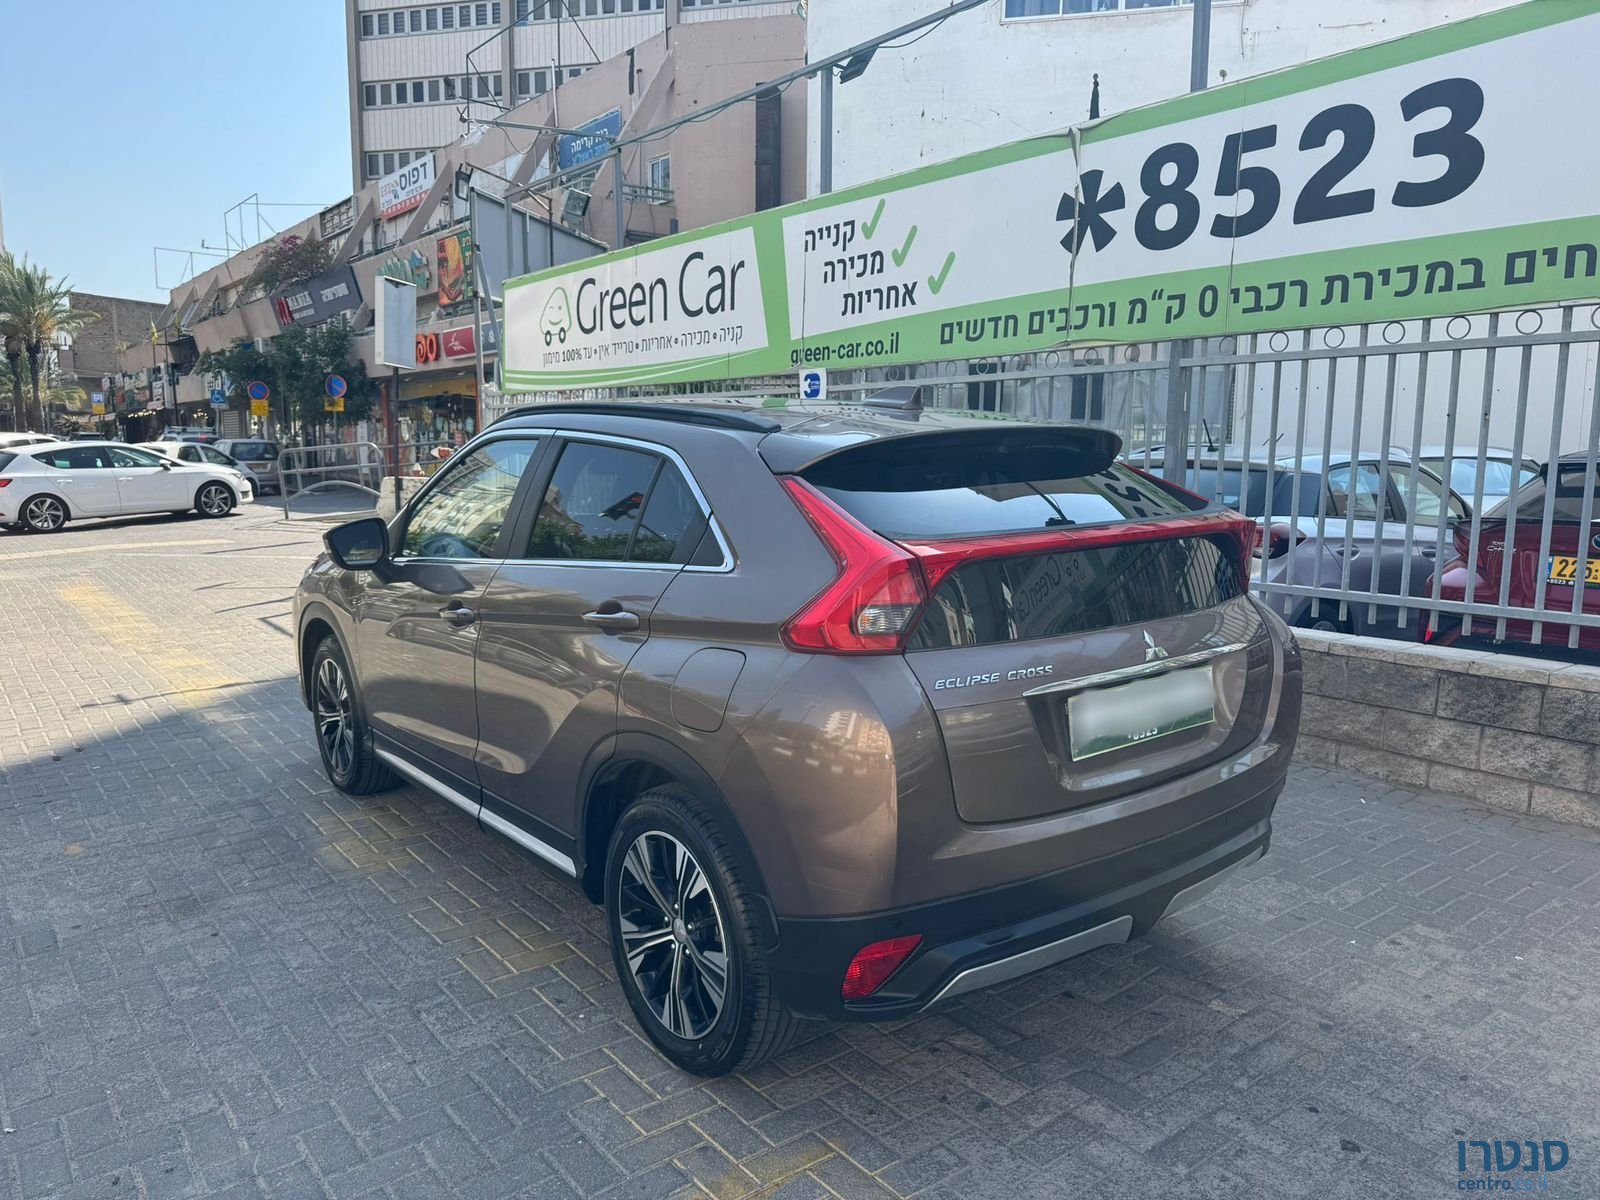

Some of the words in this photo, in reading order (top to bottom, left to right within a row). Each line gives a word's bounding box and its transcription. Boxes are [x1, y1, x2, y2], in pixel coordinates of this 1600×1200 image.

[399, 162, 427, 191] דפוס
[804, 220, 855, 252] קנייה
[823, 250, 885, 284] מכירה
[1320, 257, 1486, 306] במכירת
[576, 277, 668, 335] Green
[679, 251, 745, 318] Car
[841, 281, 918, 317] אחריות
[1229, 279, 1308, 314] רכבי
[940, 314, 1019, 345] חדשים
[1028, 301, 1117, 335] ורכבים
[611, 341, 634, 356] טרייד
[641, 336, 673, 353] אחריות
[680, 330, 711, 348] מכירה
[719, 325, 744, 346] קניה
[791, 332, 900, 367] green-car.co.il
[543, 350, 560, 369] מימון
[562, 348, 582, 364] 100%
[935, 672, 1001, 690] ECLIPSE
[1007, 665, 1053, 680] CROSS
